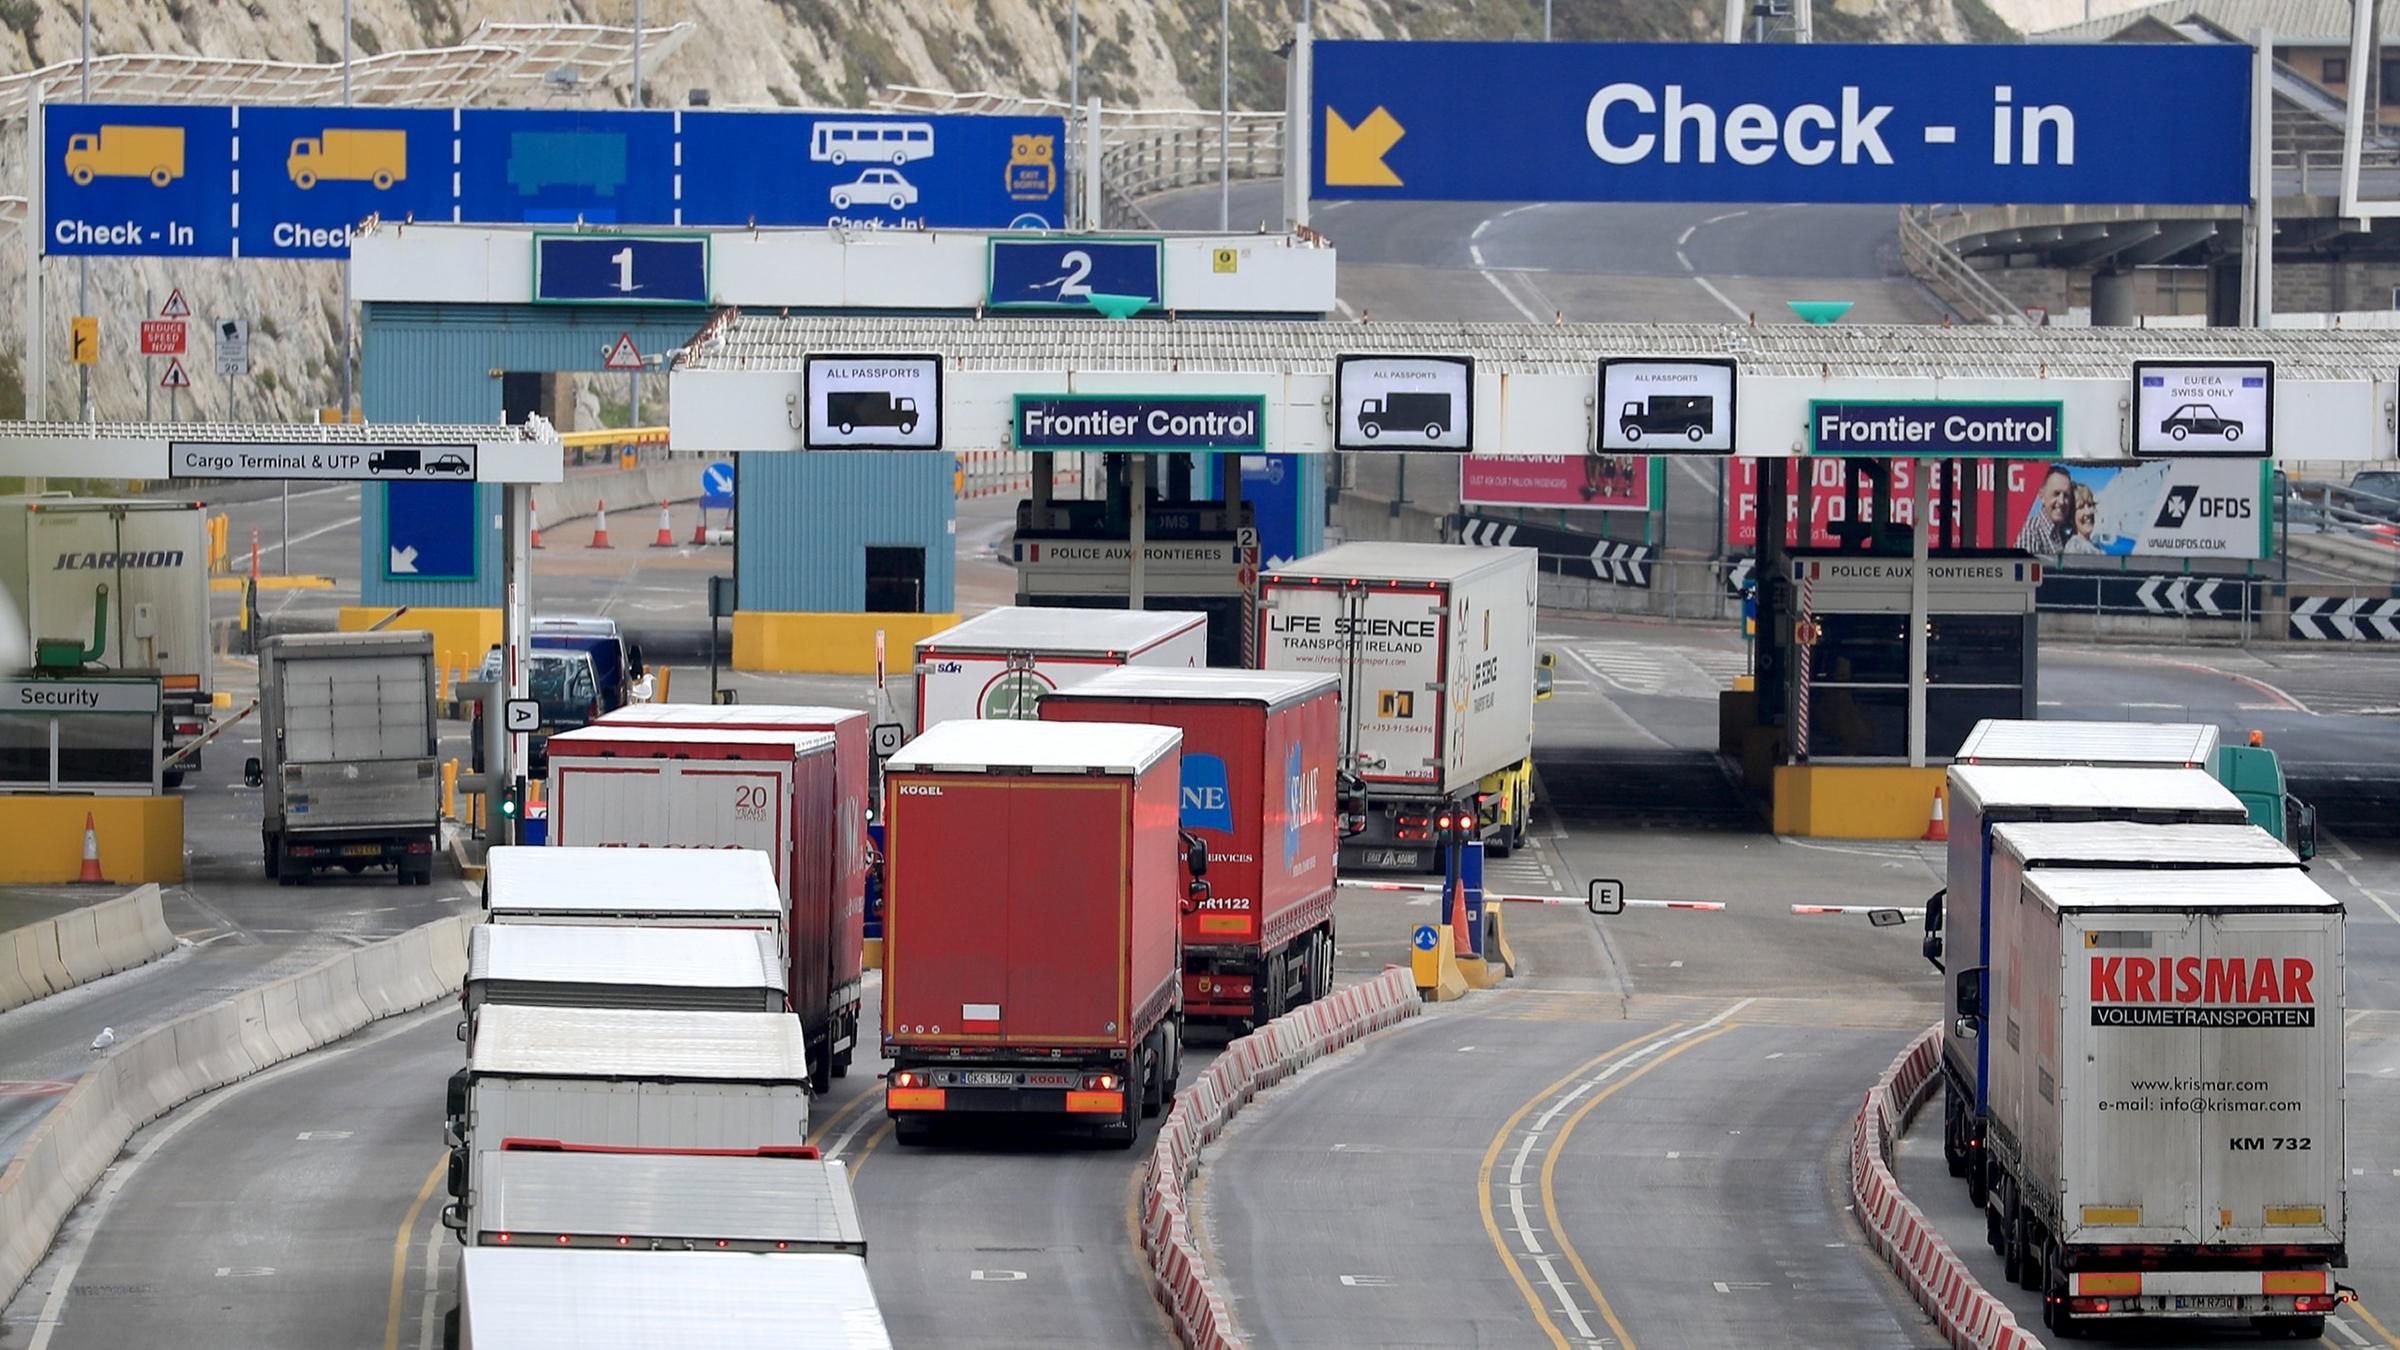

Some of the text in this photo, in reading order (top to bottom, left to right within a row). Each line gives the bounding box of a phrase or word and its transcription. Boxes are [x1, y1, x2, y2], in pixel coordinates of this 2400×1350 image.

[1585, 82, 2075, 166] Check - in
[55, 220, 143, 245] Check
[170, 222, 194, 245] In
[612, 247, 633, 292] 1
[1061, 250, 1093, 296] 2
[144, 323, 183, 332] REDUCE
[148, 333, 180, 342] SPEED
[152, 342, 176, 352] NOW
[224, 362, 239, 373] 20
[827, 368, 920, 378] ALL PASSPORTS
[1373, 371, 1437, 380] ALL PASSPORTS
[1635, 374, 1698, 382] ALL PASSPORTS
[2184, 376, 2222, 385] EU/EEA
[2171, 388, 2234, 397] SWISS ONLY
[1025, 410, 1255, 437] Frontier Control
[1821, 416, 2052, 442] Frontier Control
[186, 453, 360, 470] Cargo Terminal & UTP
[2200, 498, 2251, 518] DFDS
[1241, 531, 1251, 546] 2
[1051, 547, 1221, 561] POLICE AUX RONTIERES
[1831, 566, 2003, 578] POLICE AUX RONTIERES
[1271, 615, 1435, 638] LIFE SCIENCE
[1283, 637, 1423, 654] TRANSPORT IRELAND
[21, 688, 99, 708] Security
[516, 708, 531, 722] A
[736, 785, 767, 808] 20
[900, 785, 943, 796] KÖGEL
[1208, 853, 1253, 863] ERVICES
[1601, 889, 1612, 905] E
[2090, 956, 2315, 1003] KRISMAR
[2098, 1009, 2310, 1025] VOLUMETRANSPORTEN
[2131, 1076, 2269, 1091] www.krismar.com
[2099, 1097, 2302, 1113] e-mail: info@krismar.com
[2230, 1138, 2312, 1150] KM 732
